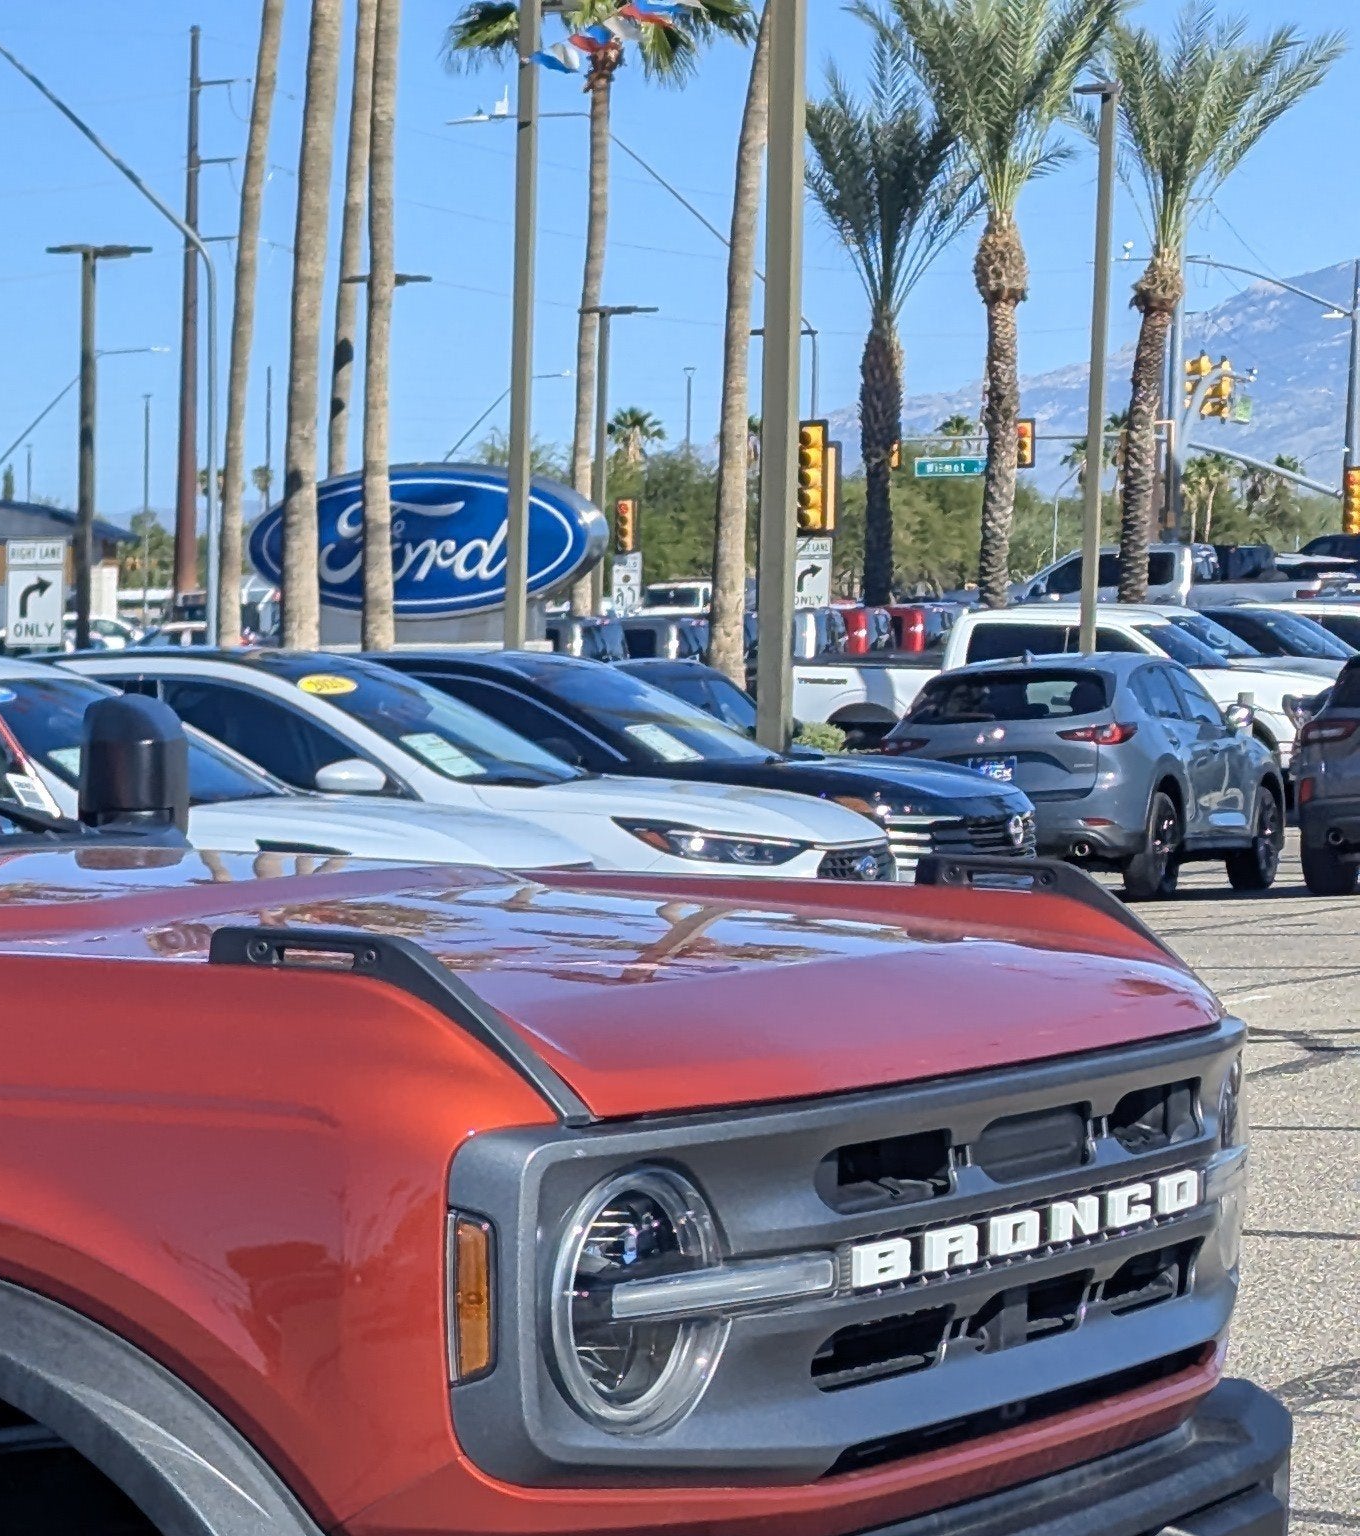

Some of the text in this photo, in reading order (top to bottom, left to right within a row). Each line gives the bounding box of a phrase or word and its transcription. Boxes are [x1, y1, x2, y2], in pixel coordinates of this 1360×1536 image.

[10, 547, 61, 560] RIGHT LANE
[13, 622, 55, 637] ONLY
[851, 1169, 1199, 1289] BRONCO
